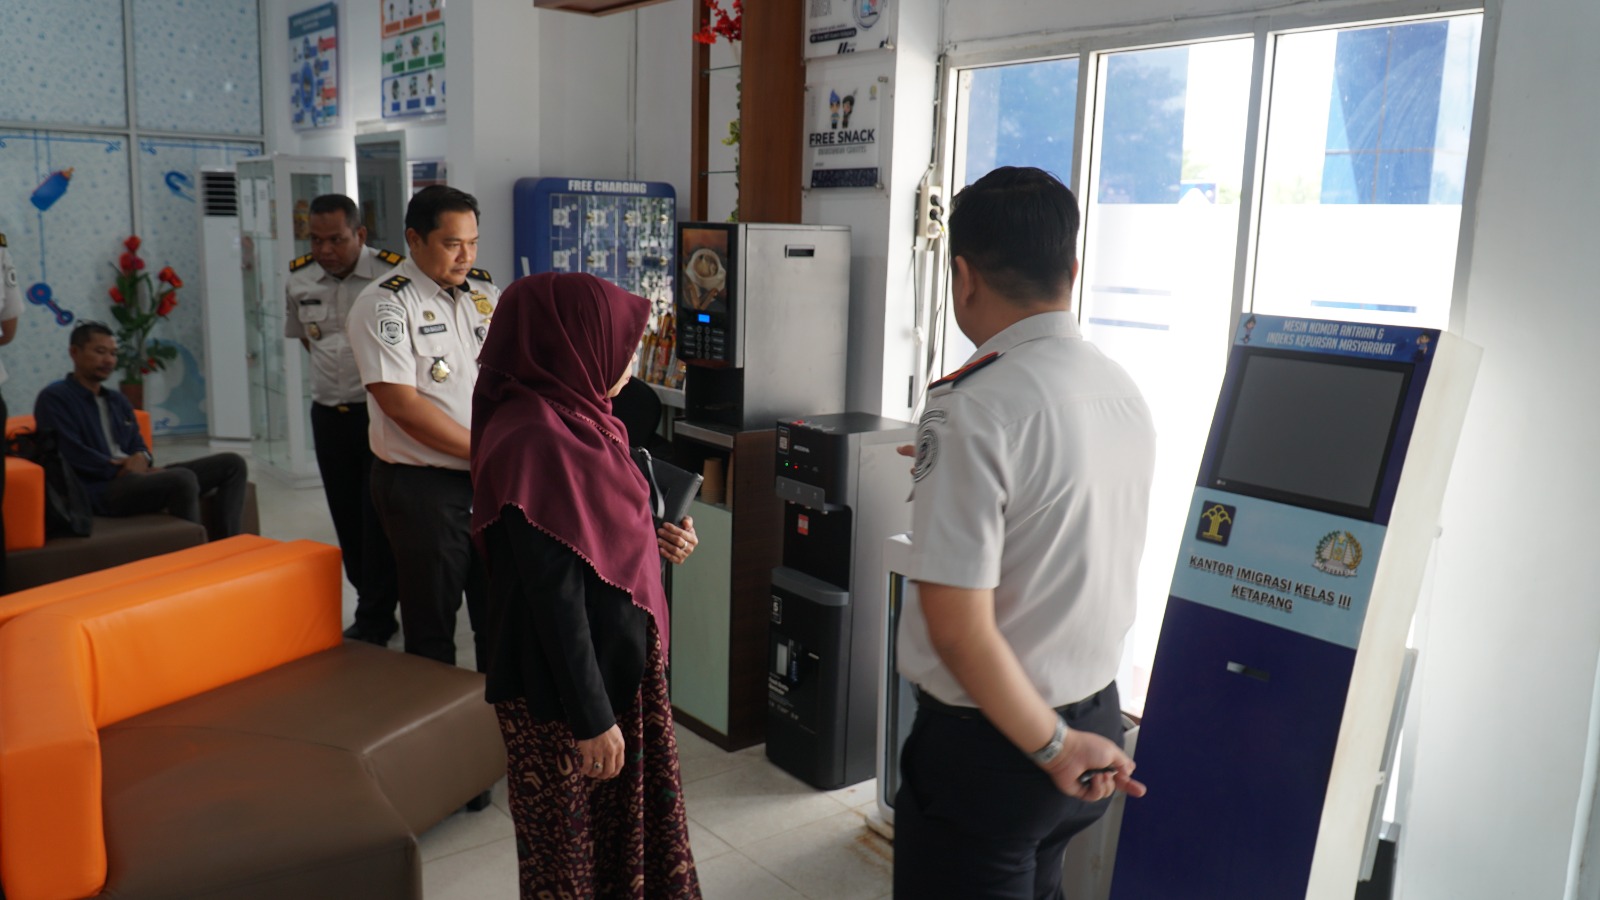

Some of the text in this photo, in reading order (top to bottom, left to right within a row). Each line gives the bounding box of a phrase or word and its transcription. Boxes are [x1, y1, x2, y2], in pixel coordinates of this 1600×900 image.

[809, 129, 875, 145] FREE SNACK
[568, 180, 647, 194] FREE CHARGING
[1283, 320, 1308, 332] MESIN
[1309, 321, 1339, 336] NOMOR
[1339, 324, 1377, 339] ANTRIAN
[1266, 332, 1396, 356] INDEKS KEPUASAN MASYARAKAT
[1189, 555, 1235, 575] KANTOR
[1236, 567, 1292, 591] IMIGRASI
[1294, 582, 1335, 603] KELAS
[1338, 594, 1352, 608] III
[1231, 584, 1294, 611] KETAPANG
